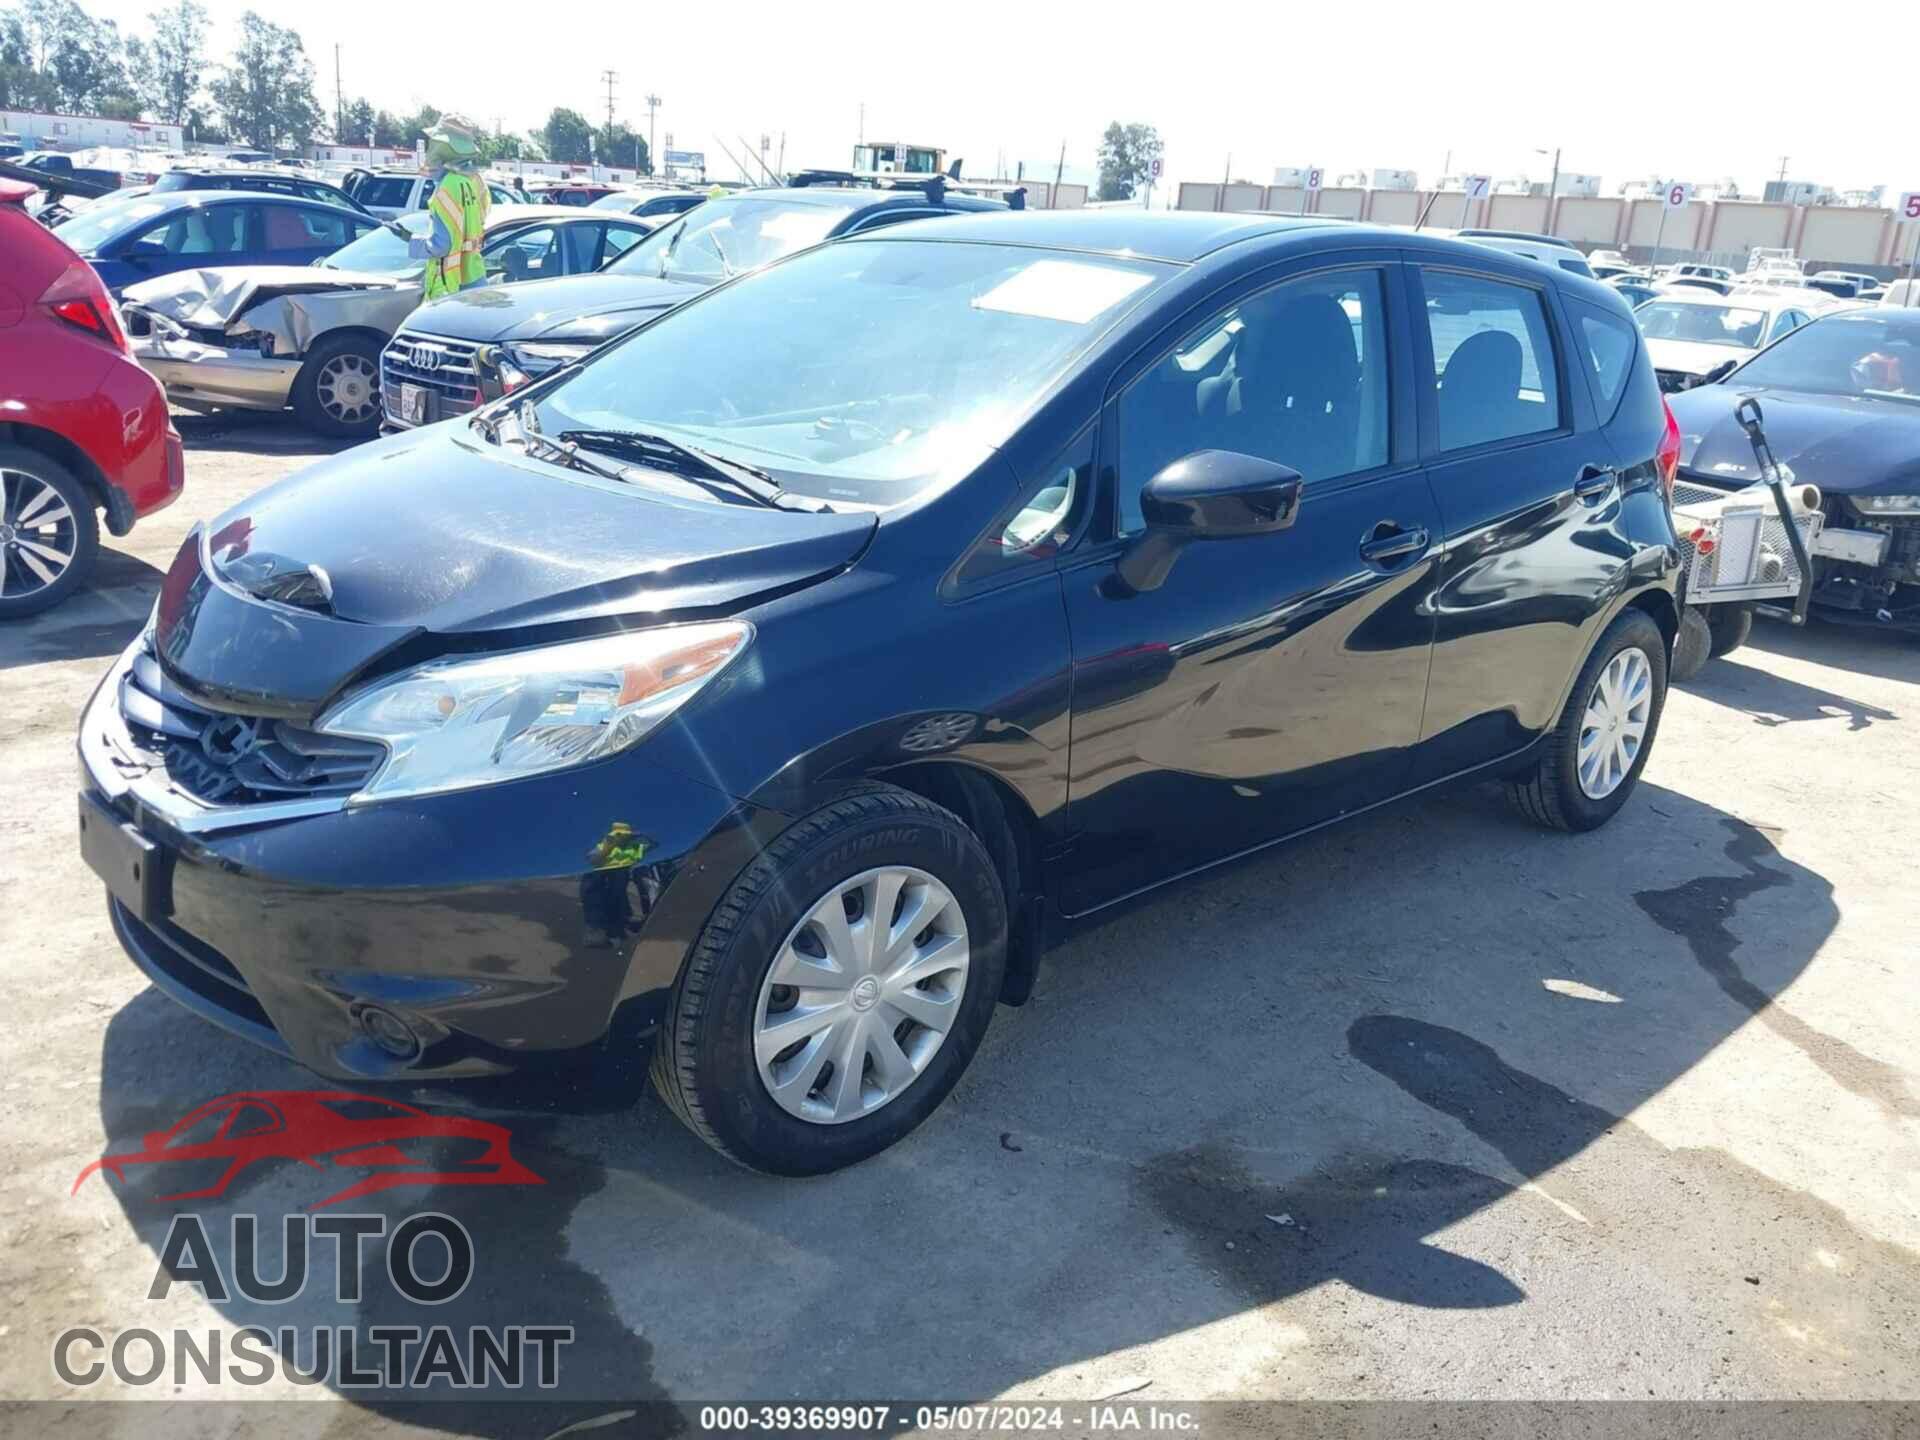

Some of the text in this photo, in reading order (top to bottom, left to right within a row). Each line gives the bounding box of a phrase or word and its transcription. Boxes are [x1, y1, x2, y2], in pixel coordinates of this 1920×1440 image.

[1151, 159, 1161, 176] 9
[1309, 170, 1320, 187] 8
[1474, 178, 1487, 196] 7
[1670, 185, 1684, 205] 6
[1905, 195, 1920, 218] 5
